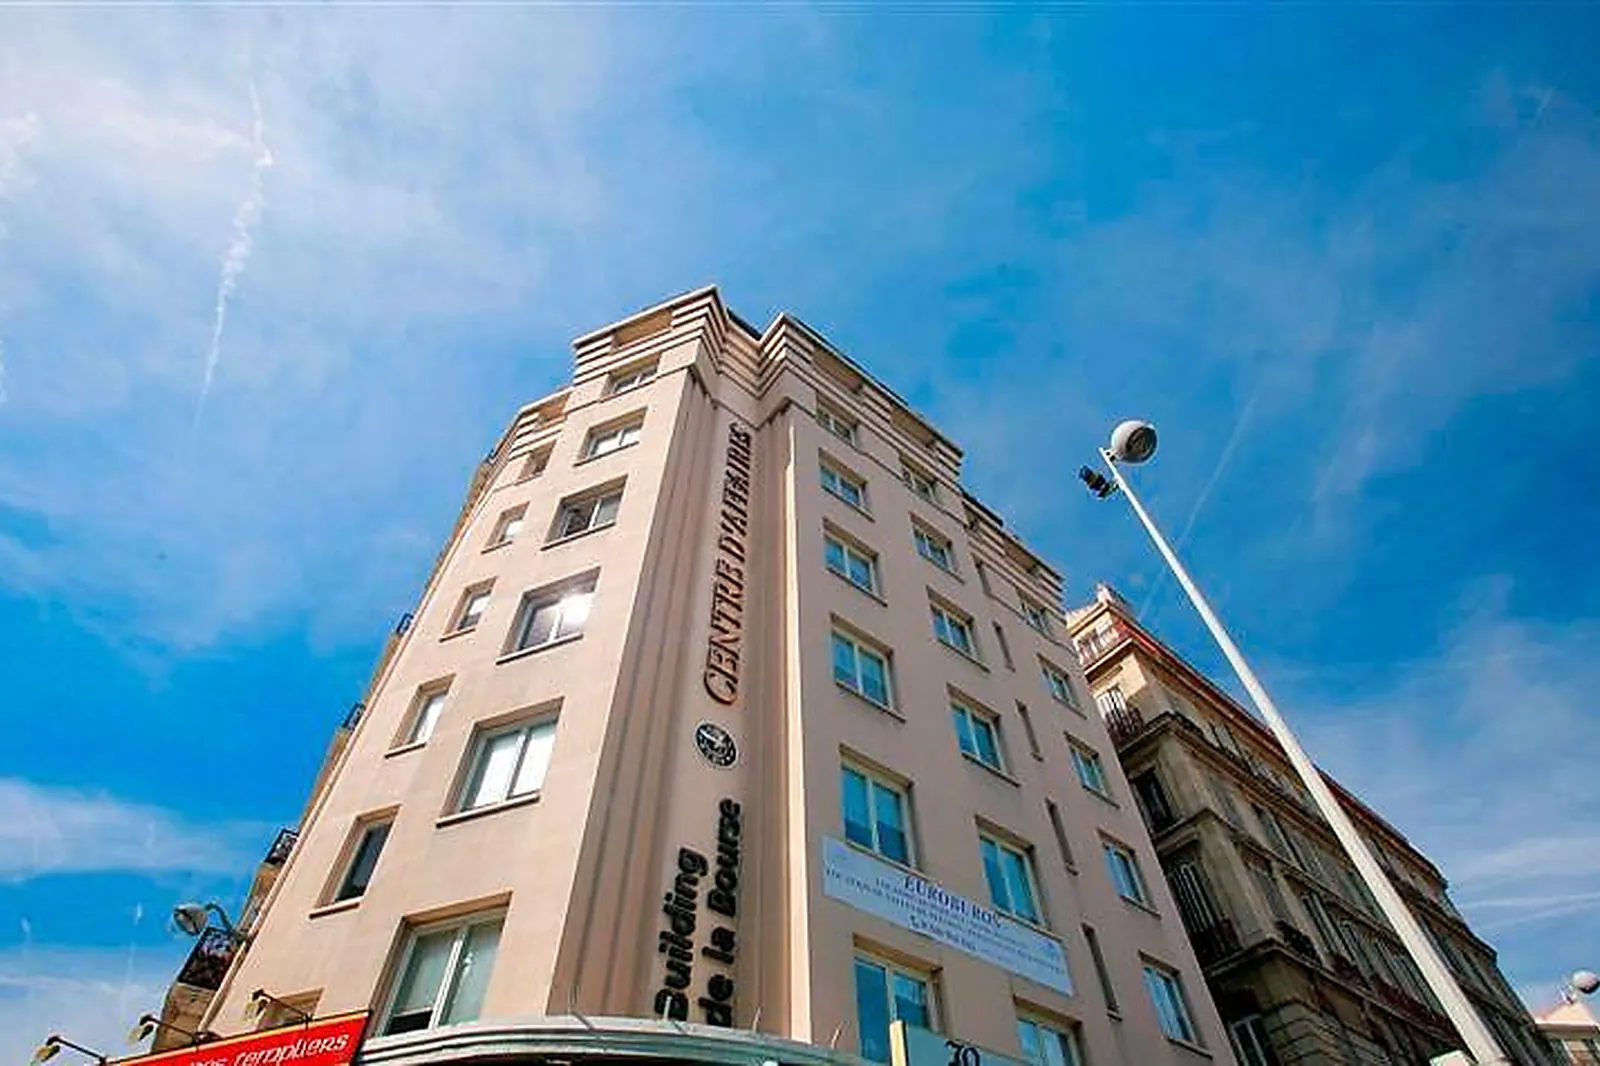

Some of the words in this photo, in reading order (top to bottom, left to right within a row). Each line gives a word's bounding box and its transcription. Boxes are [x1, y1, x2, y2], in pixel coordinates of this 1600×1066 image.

[703, 559, 745, 706] CENTRE
[707, 798, 741, 918] Bourse
[654, 847, 708, 1021] Building
[702, 926, 736, 965] la
[698, 974, 734, 1027] de
